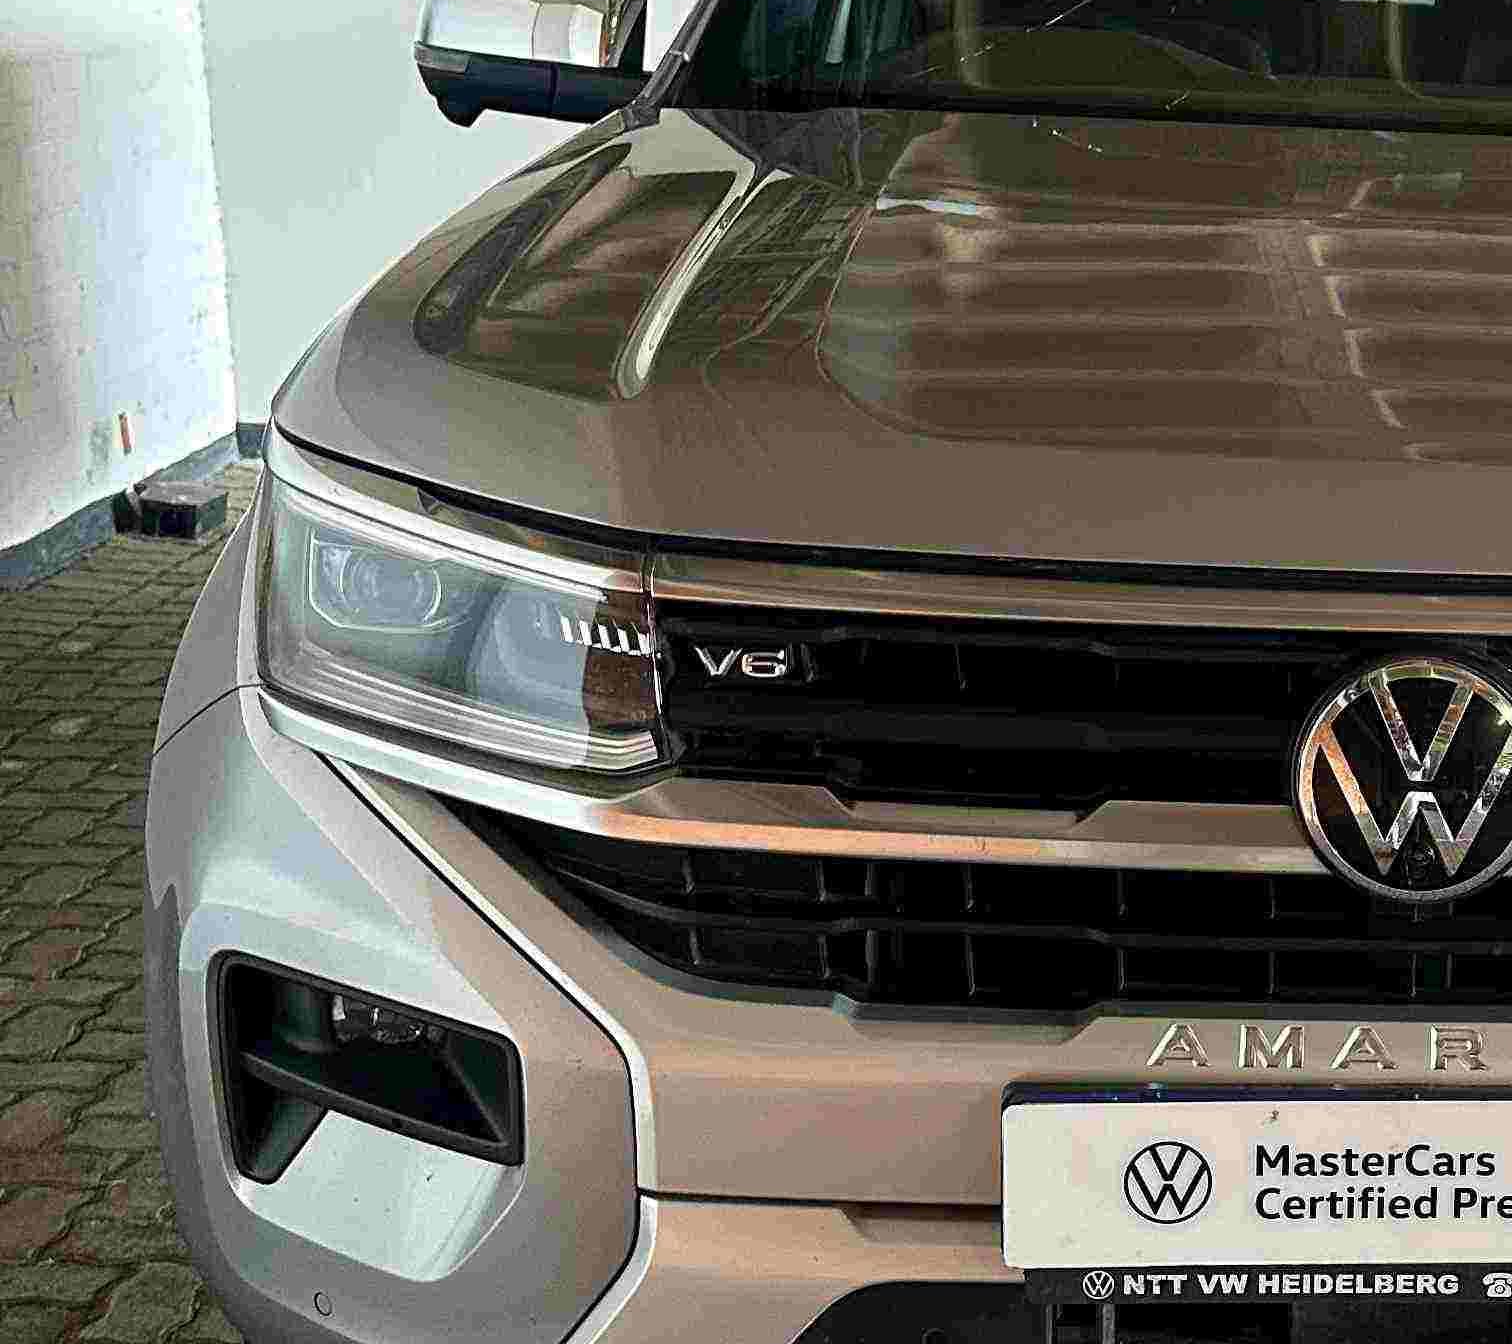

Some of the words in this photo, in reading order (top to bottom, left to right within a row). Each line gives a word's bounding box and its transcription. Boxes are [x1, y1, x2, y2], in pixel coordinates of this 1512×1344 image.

[694, 647, 787, 677] V6
[1255, 1144, 1497, 1178] MasterCars
[1255, 1185, 1438, 1221] Certified
[1123, 1274, 1187, 1295] NTT
[1197, 1274, 1249, 1295] VW
[1258, 1274, 1459, 1295] HEIDELBERG
